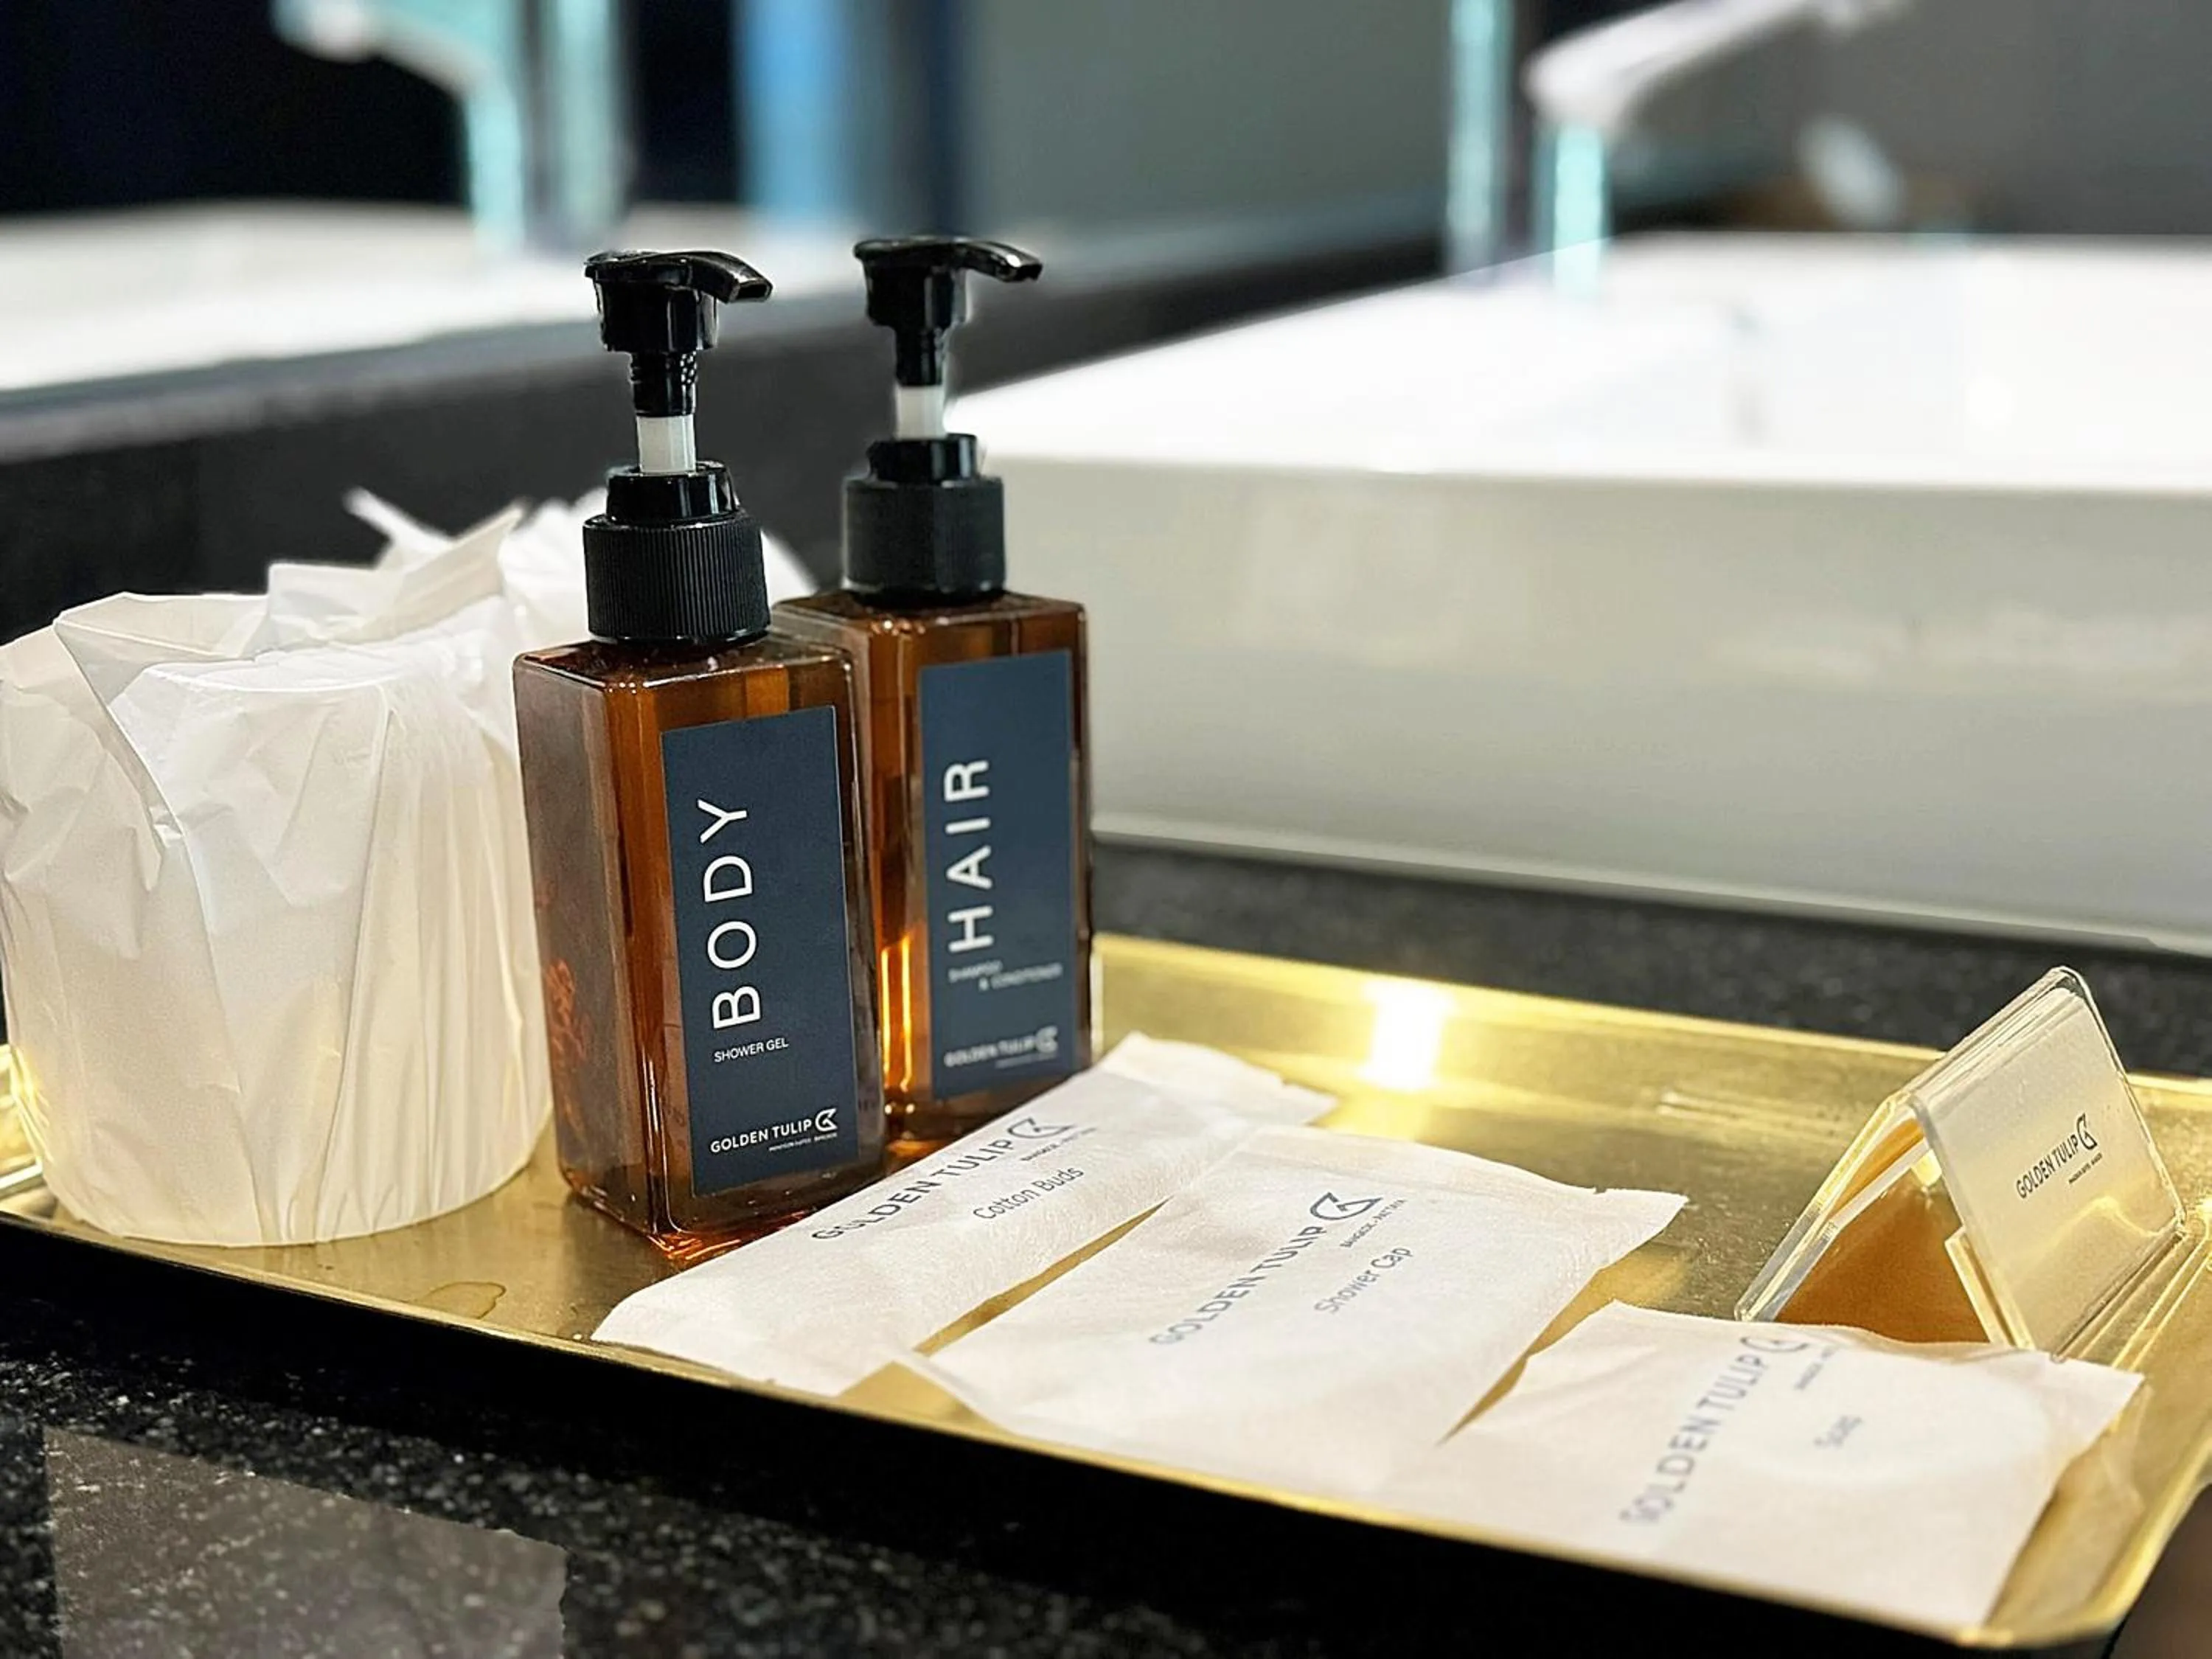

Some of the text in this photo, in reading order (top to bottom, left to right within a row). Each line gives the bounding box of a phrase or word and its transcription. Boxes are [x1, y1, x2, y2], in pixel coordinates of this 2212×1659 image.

[945, 760, 994, 953] HAIR
[697, 799, 761, 1029] BODY
[714, 1037, 789, 1062] SHOWER GEL
[710, 1128, 768, 1153] GOLDEN
[771, 1119, 813, 1139] TULIP
[931, 1138, 1014, 1180] TULIP
[2016, 1154, 2056, 1198] GOLDEN
[2051, 1134, 2079, 1167] TULIP
[973, 1166, 1085, 1220] Cotton Buds
[1149, 1225, 1328, 1345] GOLDEN TULIP
[1314, 1246, 1413, 1315] Shower Cap
[1696, 1353, 1769, 1411] TULIP
